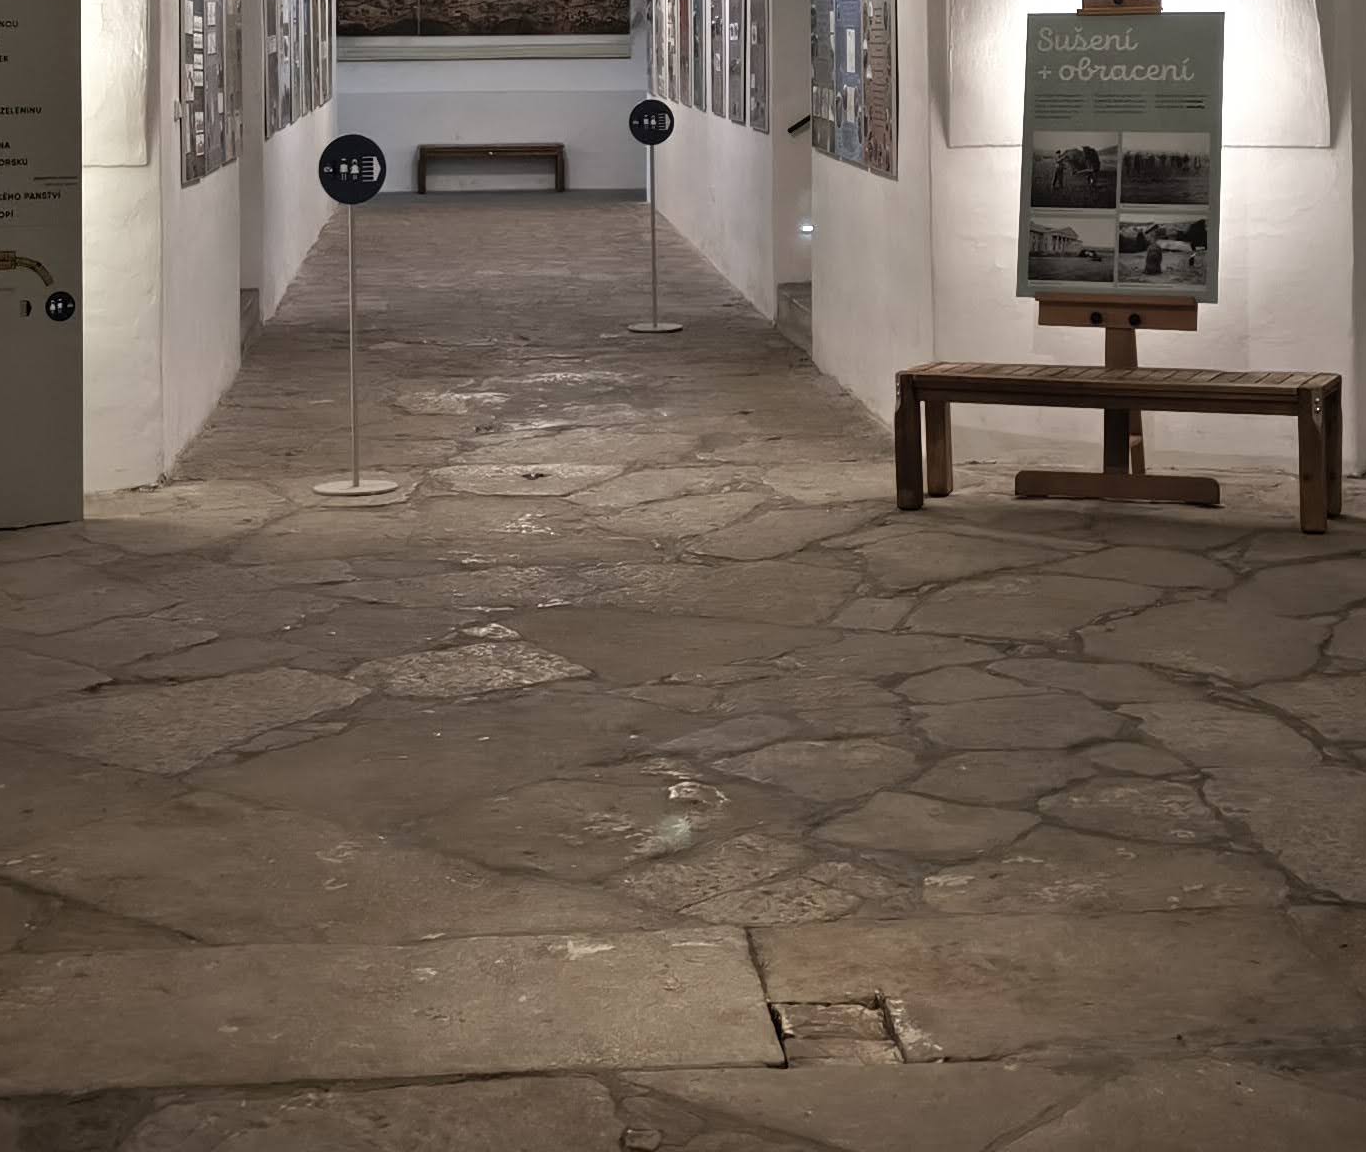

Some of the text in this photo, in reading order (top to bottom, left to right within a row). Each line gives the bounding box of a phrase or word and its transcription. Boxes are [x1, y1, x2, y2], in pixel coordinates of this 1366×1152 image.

[1037, 26, 1139, 51] Sušení
[1038, 57, 1195, 81] + obracení
[0, 106, 42, 115] ZELENINU
